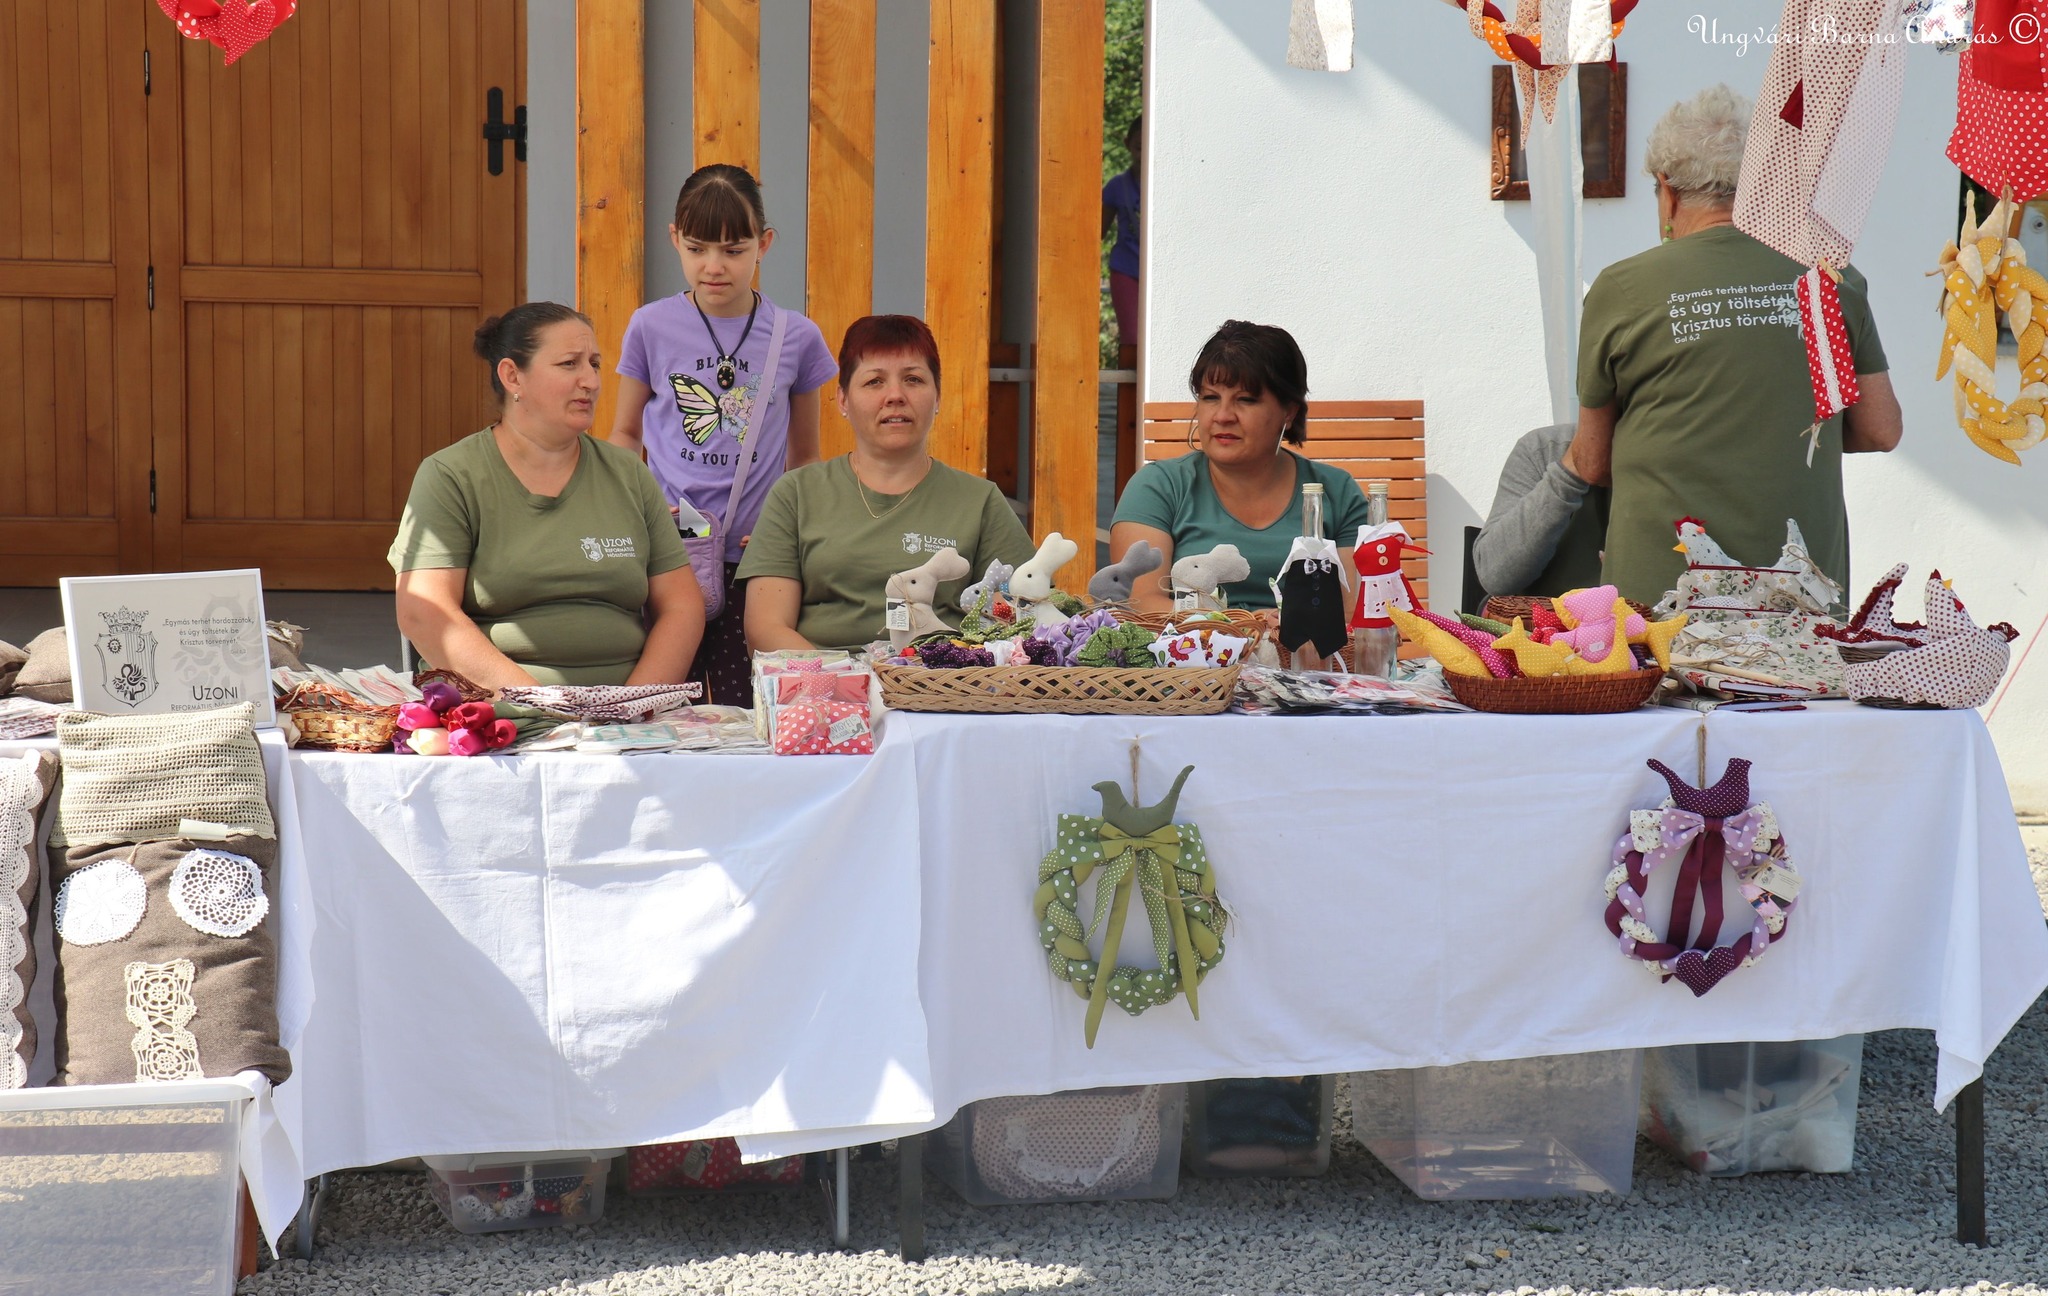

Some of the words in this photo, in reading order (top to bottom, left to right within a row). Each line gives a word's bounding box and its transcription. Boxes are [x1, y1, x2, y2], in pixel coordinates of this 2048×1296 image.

[1716, 286, 1748, 295] terhét
[1750, 282, 1796, 293] hordozz
[1669, 305, 1687, 318] és
[1691, 300, 1722, 315] úgy
[1671, 317, 1732, 336] Krisztus
[1674, 336, 1687, 344] Gal
[1689, 333, 1700, 342] 6,2
[680, 447, 695, 462] as
[702, 453, 728, 466] YOU
[735, 451, 758, 466] ae
[600, 537, 633, 548] UZONI
[924, 535, 957, 547] UZONI
[192, 617, 211, 625] terhét
[188, 628, 200, 636] úgy
[180, 638, 204, 646] Krisztus
[192, 685, 238, 701] UZONI
[170, 702, 213, 712] REFORMÁTUS
